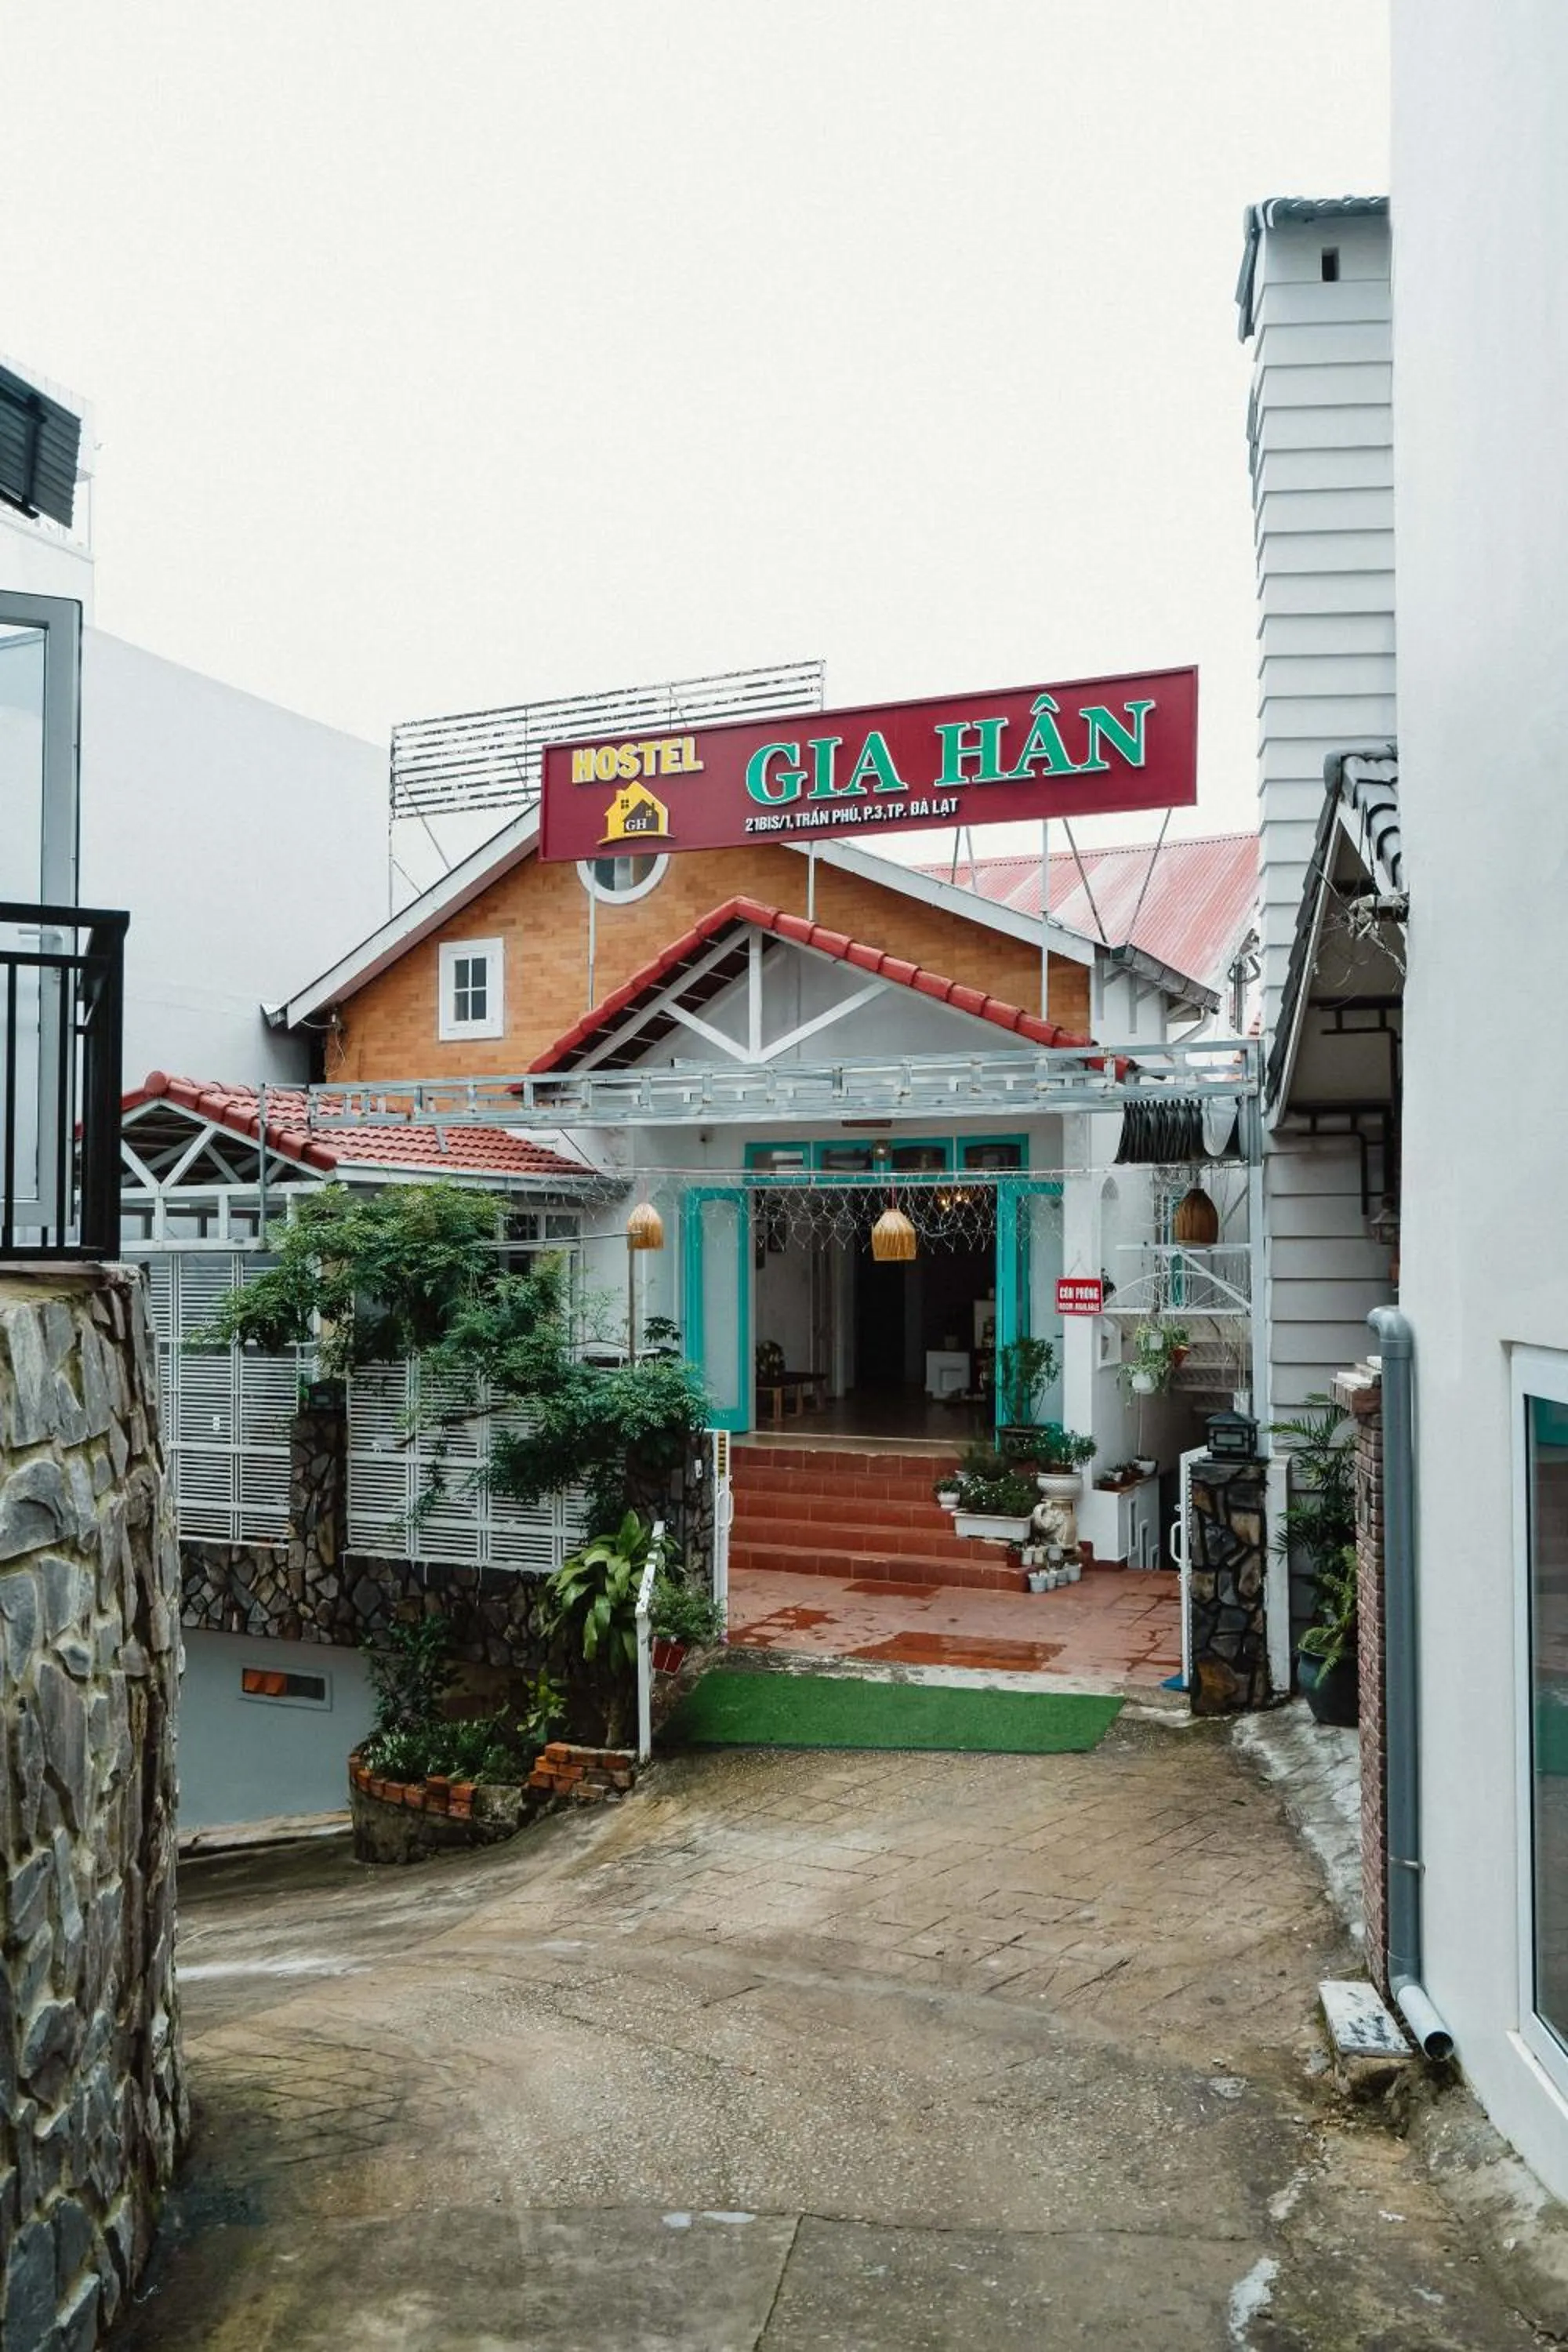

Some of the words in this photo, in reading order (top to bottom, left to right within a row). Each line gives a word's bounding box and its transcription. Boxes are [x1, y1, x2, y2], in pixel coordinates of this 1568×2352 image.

[572, 736, 704, 783] HOSTEL
[746, 731, 909, 806] GIA
[935, 693, 1156, 787] HÂN
[932, 797, 958, 816] LẠT
[626, 818, 646, 831] GH
